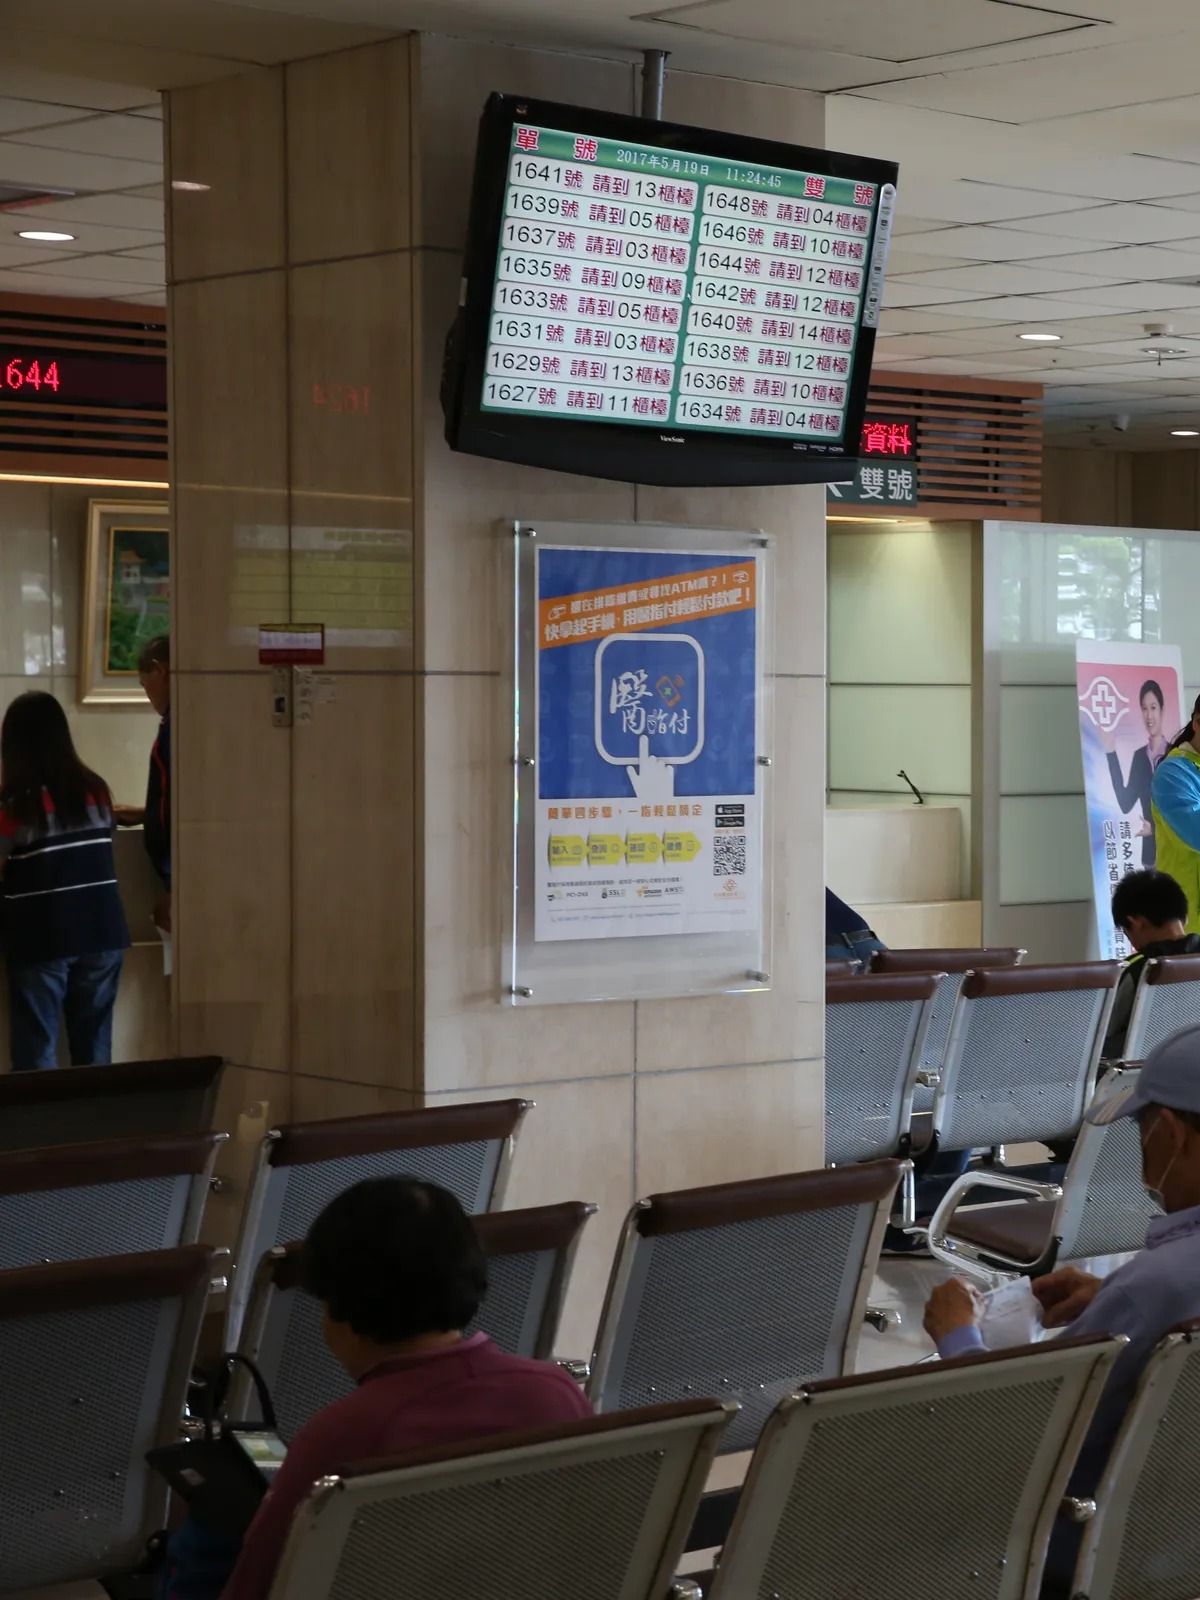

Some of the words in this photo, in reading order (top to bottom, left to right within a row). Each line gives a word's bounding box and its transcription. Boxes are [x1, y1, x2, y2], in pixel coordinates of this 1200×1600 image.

[616, 149, 710, 177] 2017年5月19日
[726, 167, 782, 188] 11:24:45
[0, 359, 60, 392] 644
[863, 423, 912, 455] 資料
[860, 466, 913, 501] 雙號
